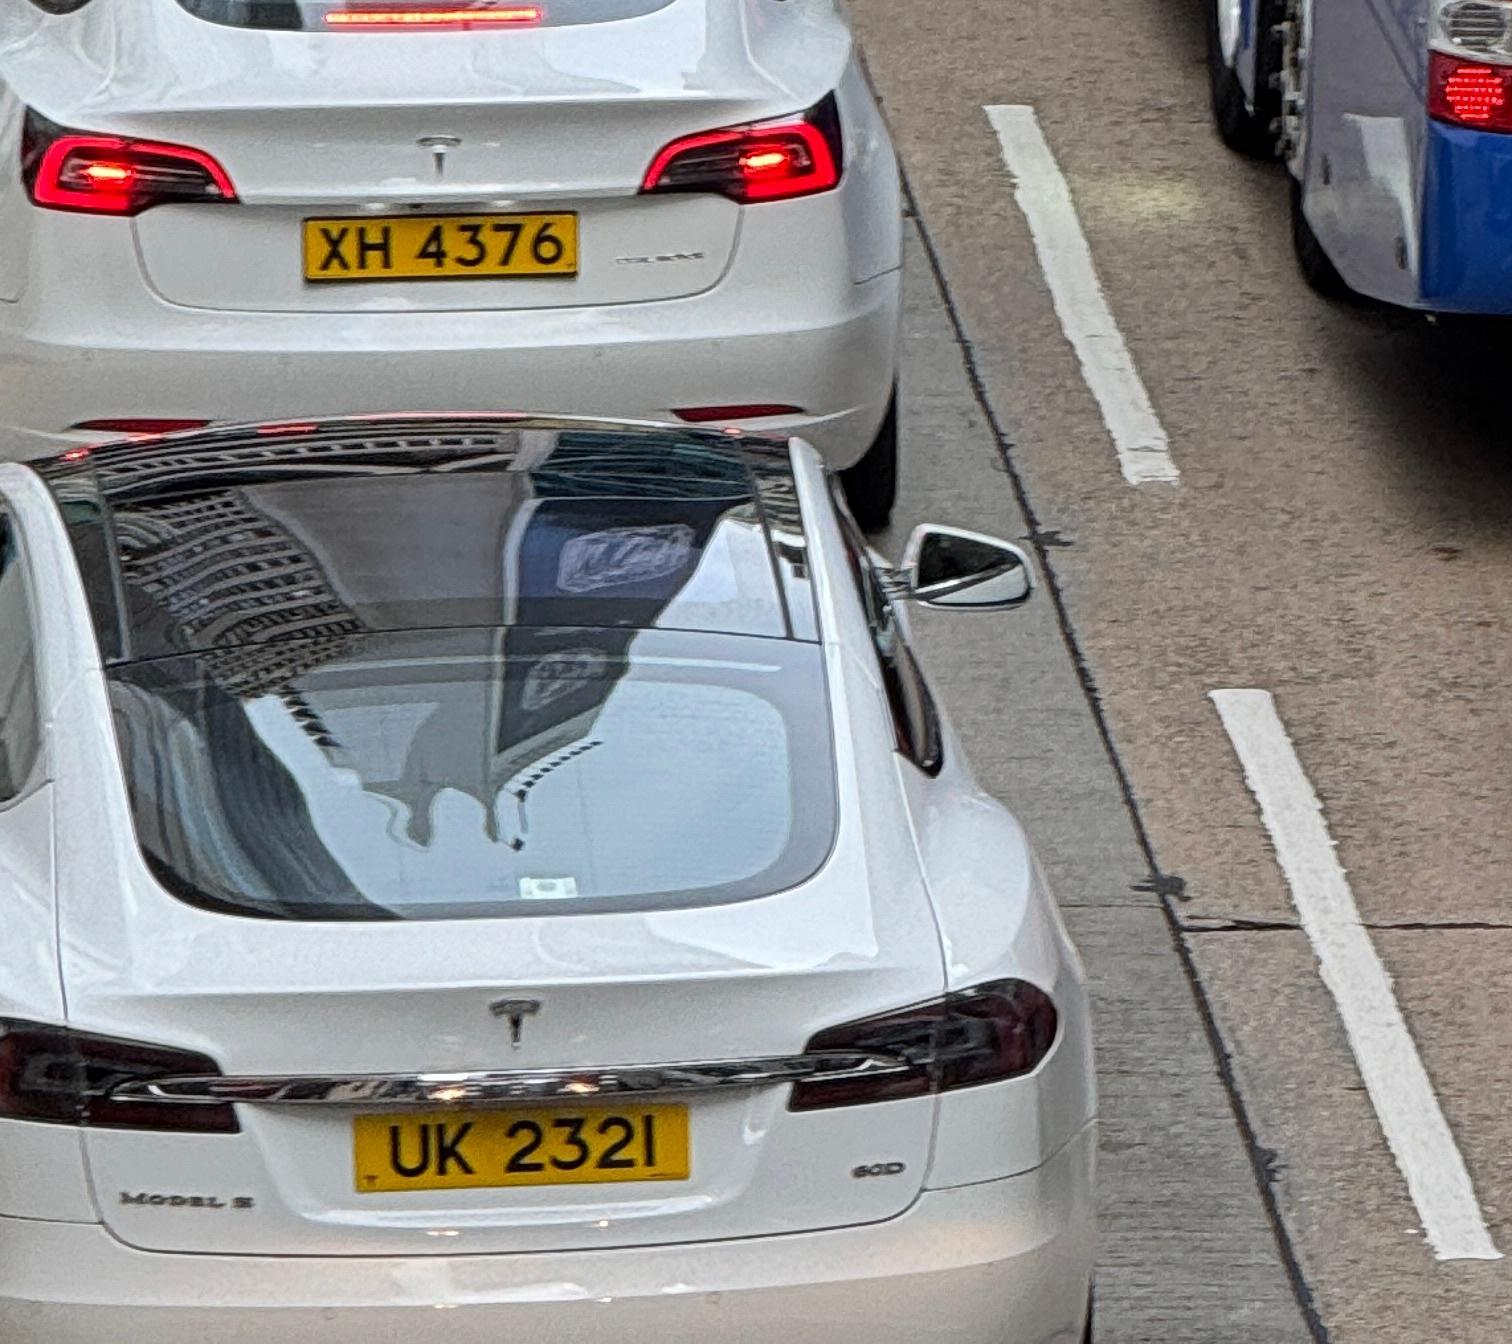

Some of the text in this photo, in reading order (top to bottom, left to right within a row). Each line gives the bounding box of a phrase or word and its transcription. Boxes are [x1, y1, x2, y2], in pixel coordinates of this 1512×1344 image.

[319, 221, 564, 274] XH 4376
[389, 1114, 658, 1179] UK 2321
[119, 1191, 225, 1209] MODEL
